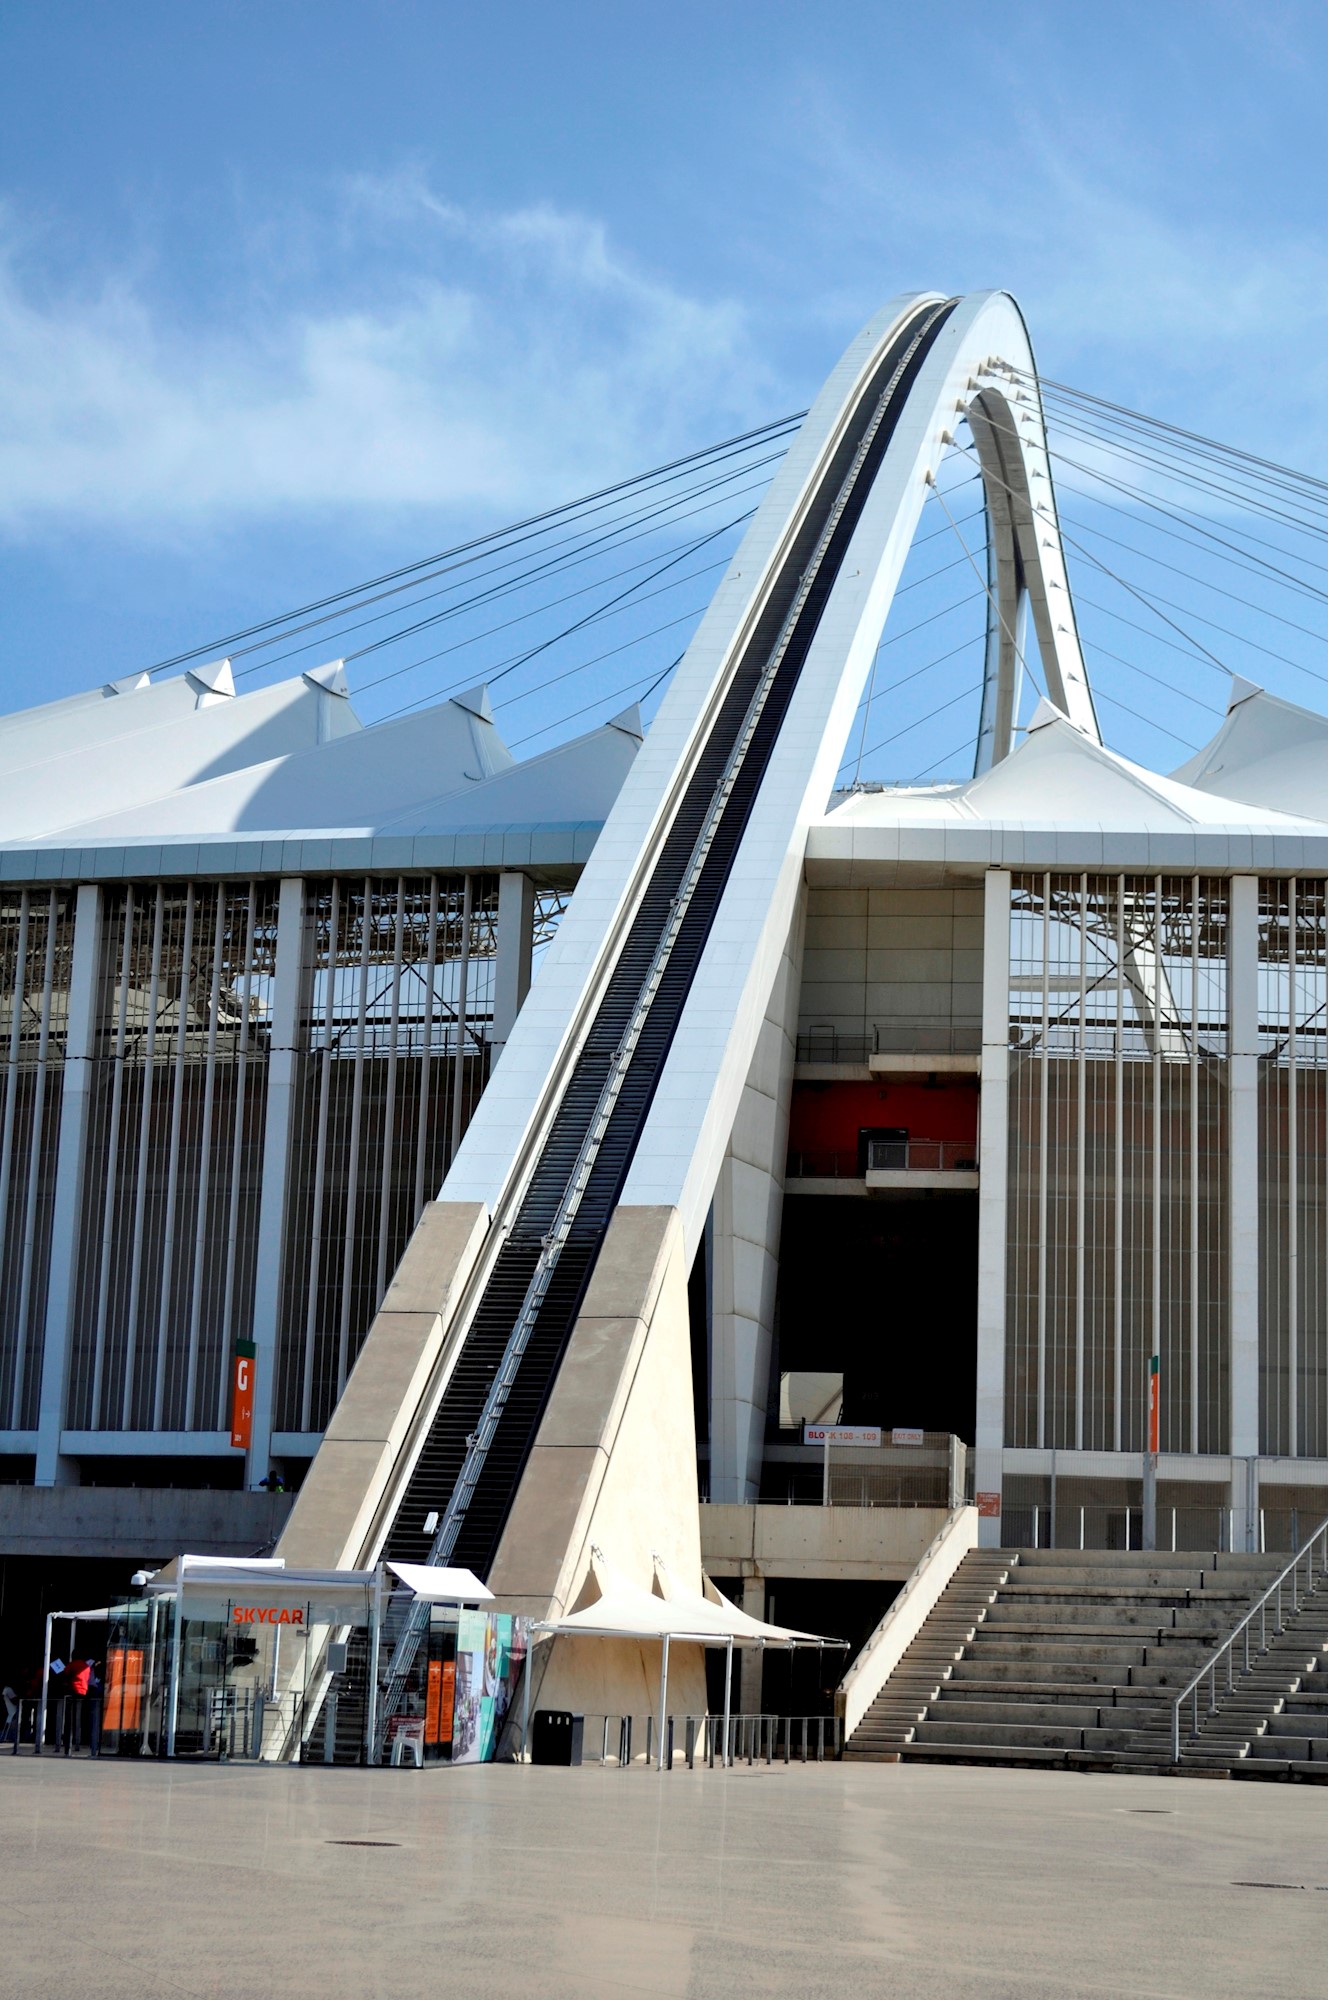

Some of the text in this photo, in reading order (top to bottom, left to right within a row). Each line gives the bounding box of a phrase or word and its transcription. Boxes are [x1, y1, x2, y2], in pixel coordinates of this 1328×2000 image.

[237, 1360, 248, 1391] G
[808, 1431, 837, 1440] BLOK
[839, 1432, 854, 1440] 108
[862, 1432, 877, 1441] 109
[232, 1606, 304, 1624] SKYCAR
